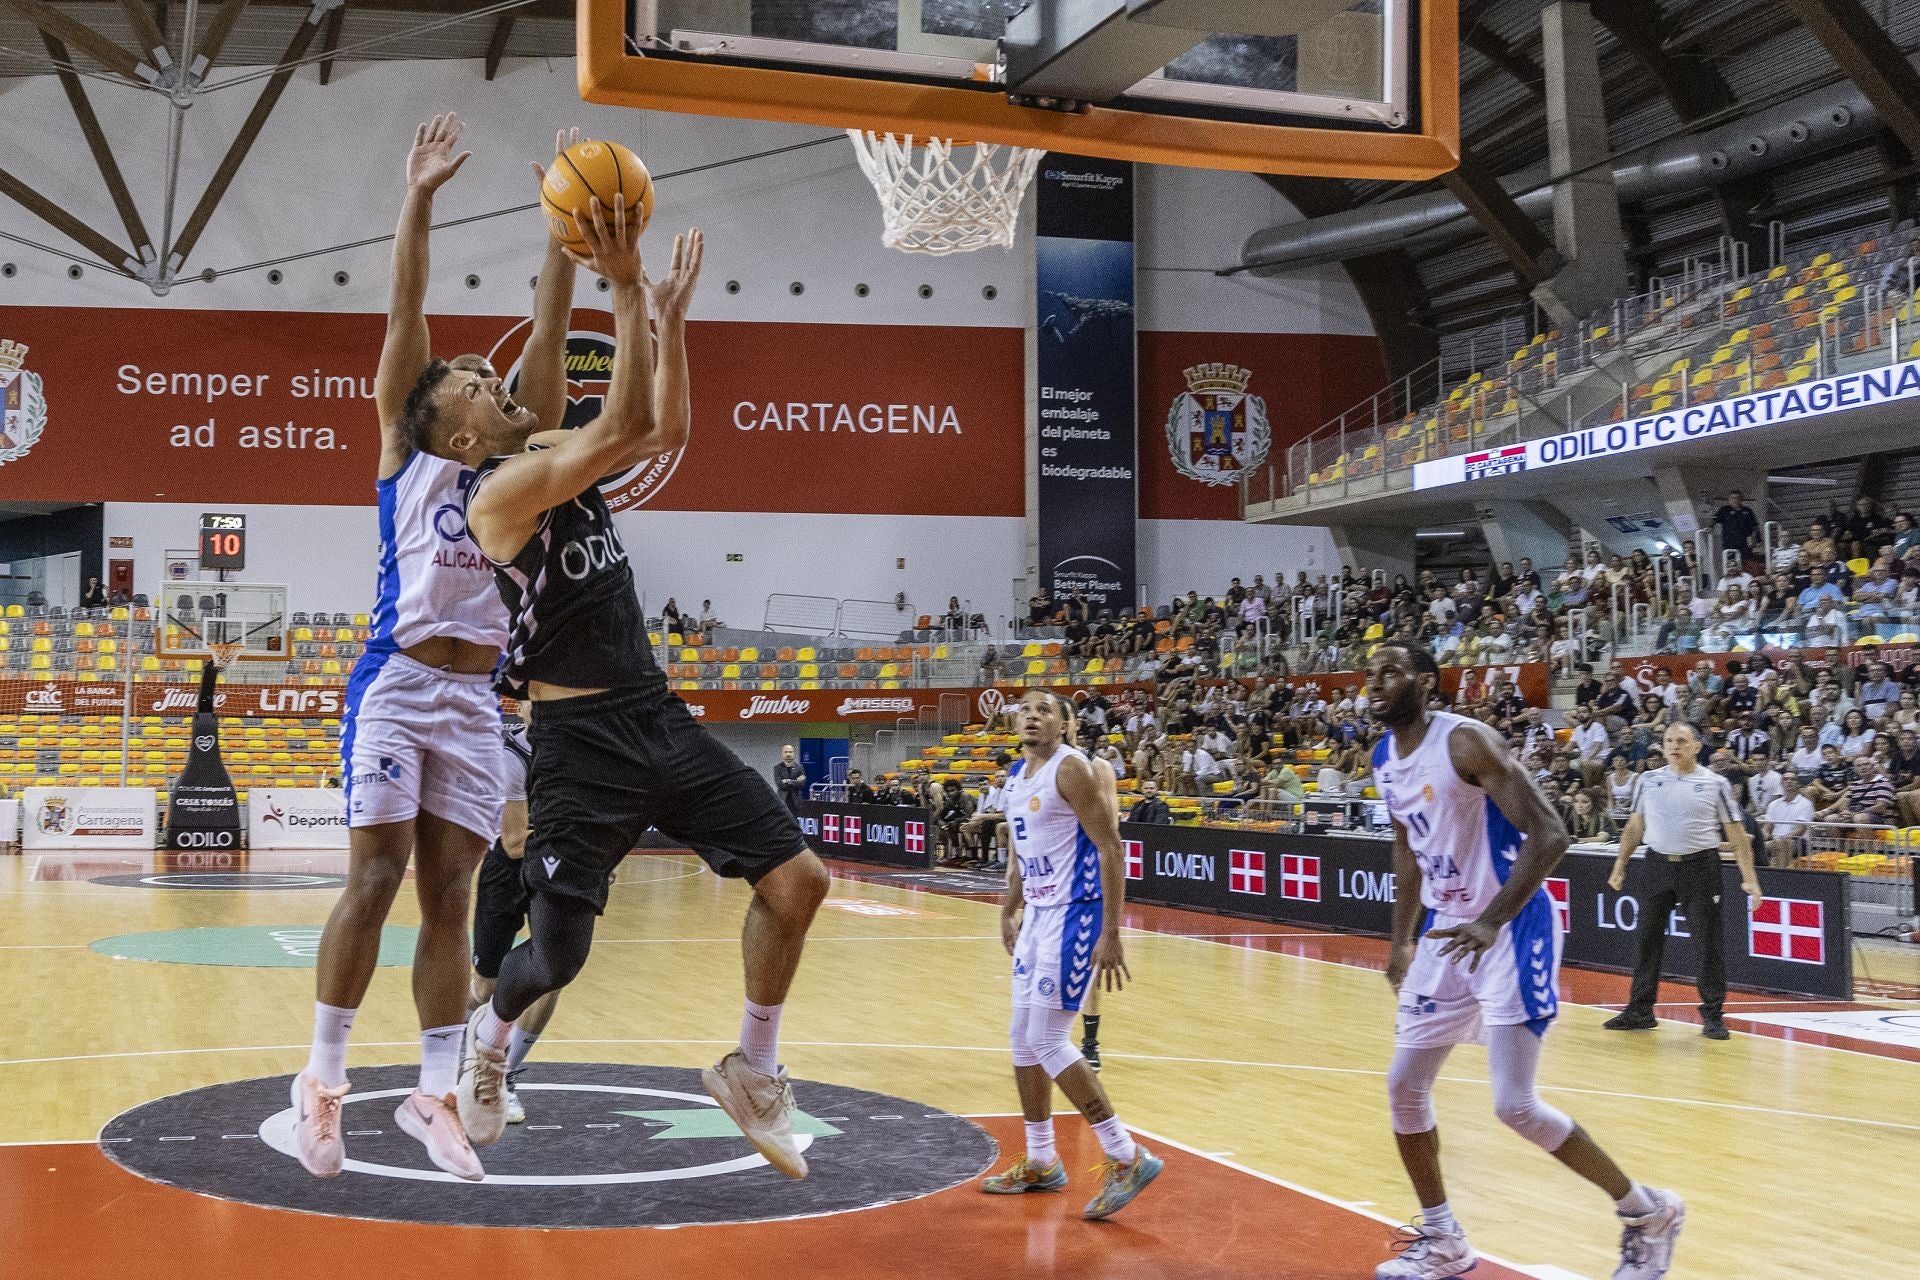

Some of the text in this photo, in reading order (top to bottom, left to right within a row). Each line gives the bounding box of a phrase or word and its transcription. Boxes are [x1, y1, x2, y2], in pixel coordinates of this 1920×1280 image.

[116, 364, 378, 402] Semper simu
[1041, 386, 1094, 403] El mejor
[732, 401, 963, 435] CARTAGENA
[1041, 407, 1100, 423] embalaje
[1540, 364, 1920, 464] ODILO FC CARTAGENA
[168, 418, 349, 450] ad astra.
[1041, 425, 1112, 441] del planeta
[1041, 447, 1058, 457] es
[1041, 463, 1133, 481] biodegradable
[211, 516, 243, 529] 7:50
[209, 533, 241, 556] 10
[431, 549, 492, 571] ALICAN
[1053, 579, 1122, 591] Better Planet
[25, 690, 63, 704] CRC
[739, 695, 811, 719] Jimbee
[77, 814, 144, 829] Cartagena
[288, 815, 348, 829] Deporte
[1013, 816, 1028, 841] 2
[176, 832, 234, 848] ODILO
[1155, 850, 1215, 881] LOMEN
[1338, 869, 1398, 903] LOME
